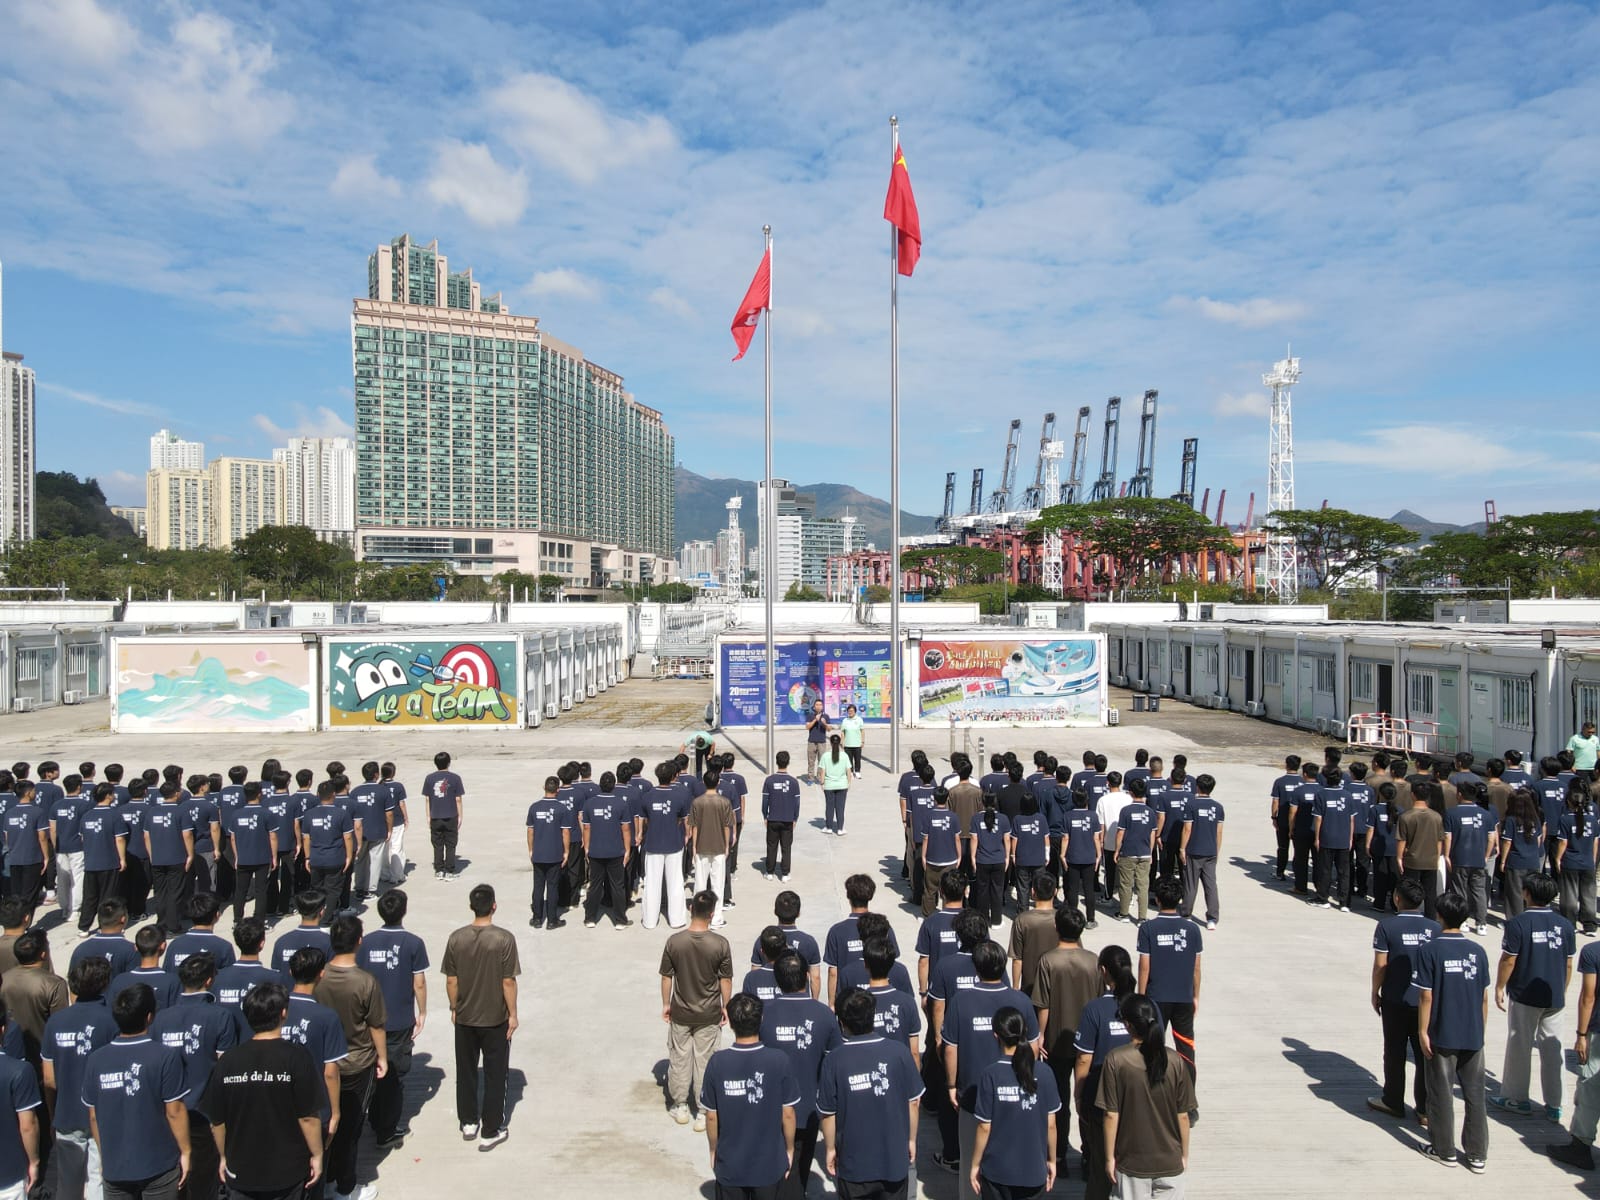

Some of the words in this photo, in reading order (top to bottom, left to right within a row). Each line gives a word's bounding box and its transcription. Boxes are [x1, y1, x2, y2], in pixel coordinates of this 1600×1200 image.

[776, 1026, 796, 1035] CADET
[100, 1072, 123, 1082] CADET
[251, 1071, 262, 1081] de
[264, 1071, 273, 1081] la
[277, 1072, 291, 1082] vie
[848, 1074, 870, 1084] CADET
[724, 1080, 746, 1089] CADET
